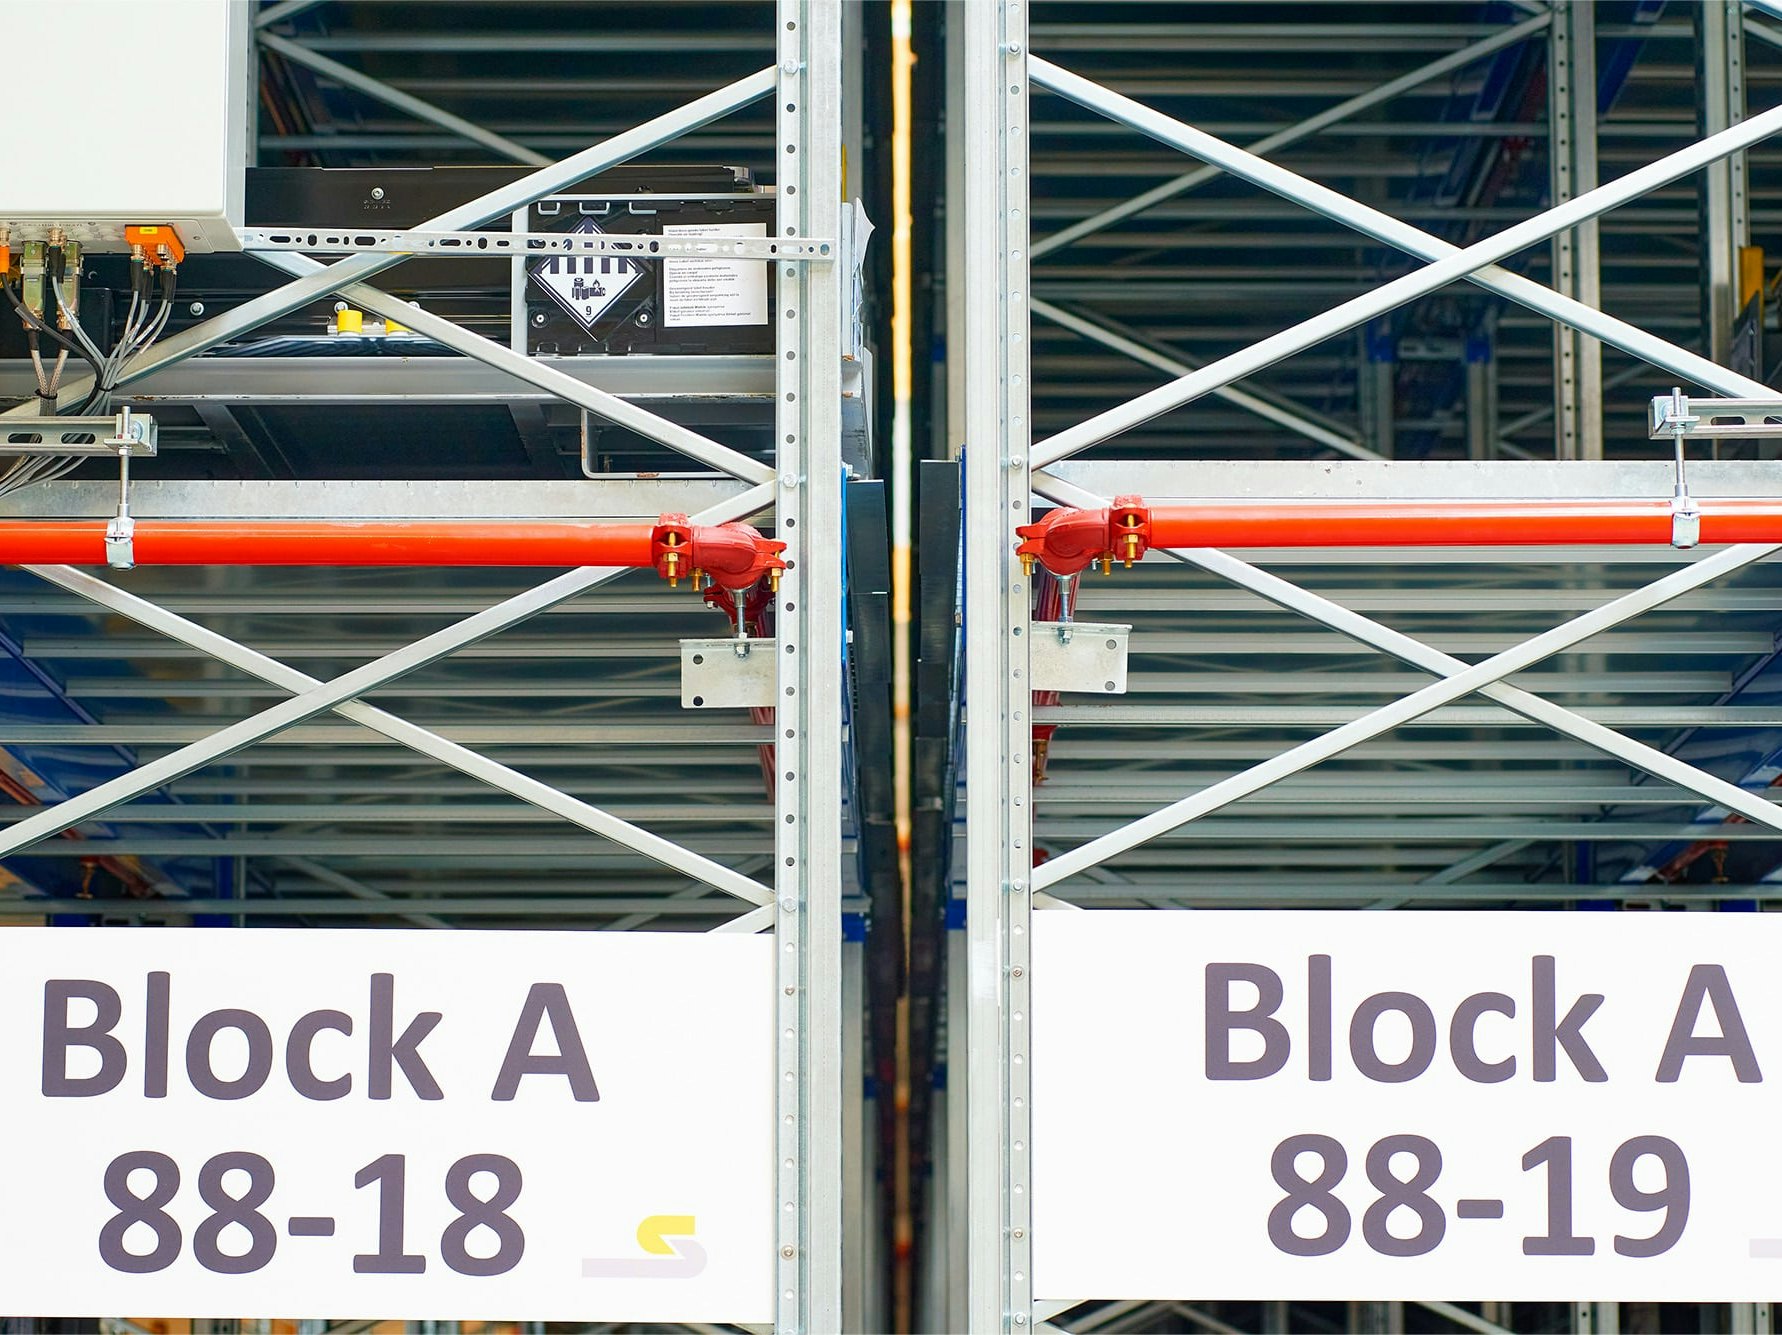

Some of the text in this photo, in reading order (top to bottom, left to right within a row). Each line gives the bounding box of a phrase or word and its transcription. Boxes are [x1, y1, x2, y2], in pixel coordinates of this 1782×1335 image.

[585, 305, 592, 316] 9
[42, 971, 600, 1102] Block A
[1205, 954, 1763, 1083] Block A
[99, 1151, 525, 1276] 88-18
[1268, 1134, 1690, 1258] 88-19
